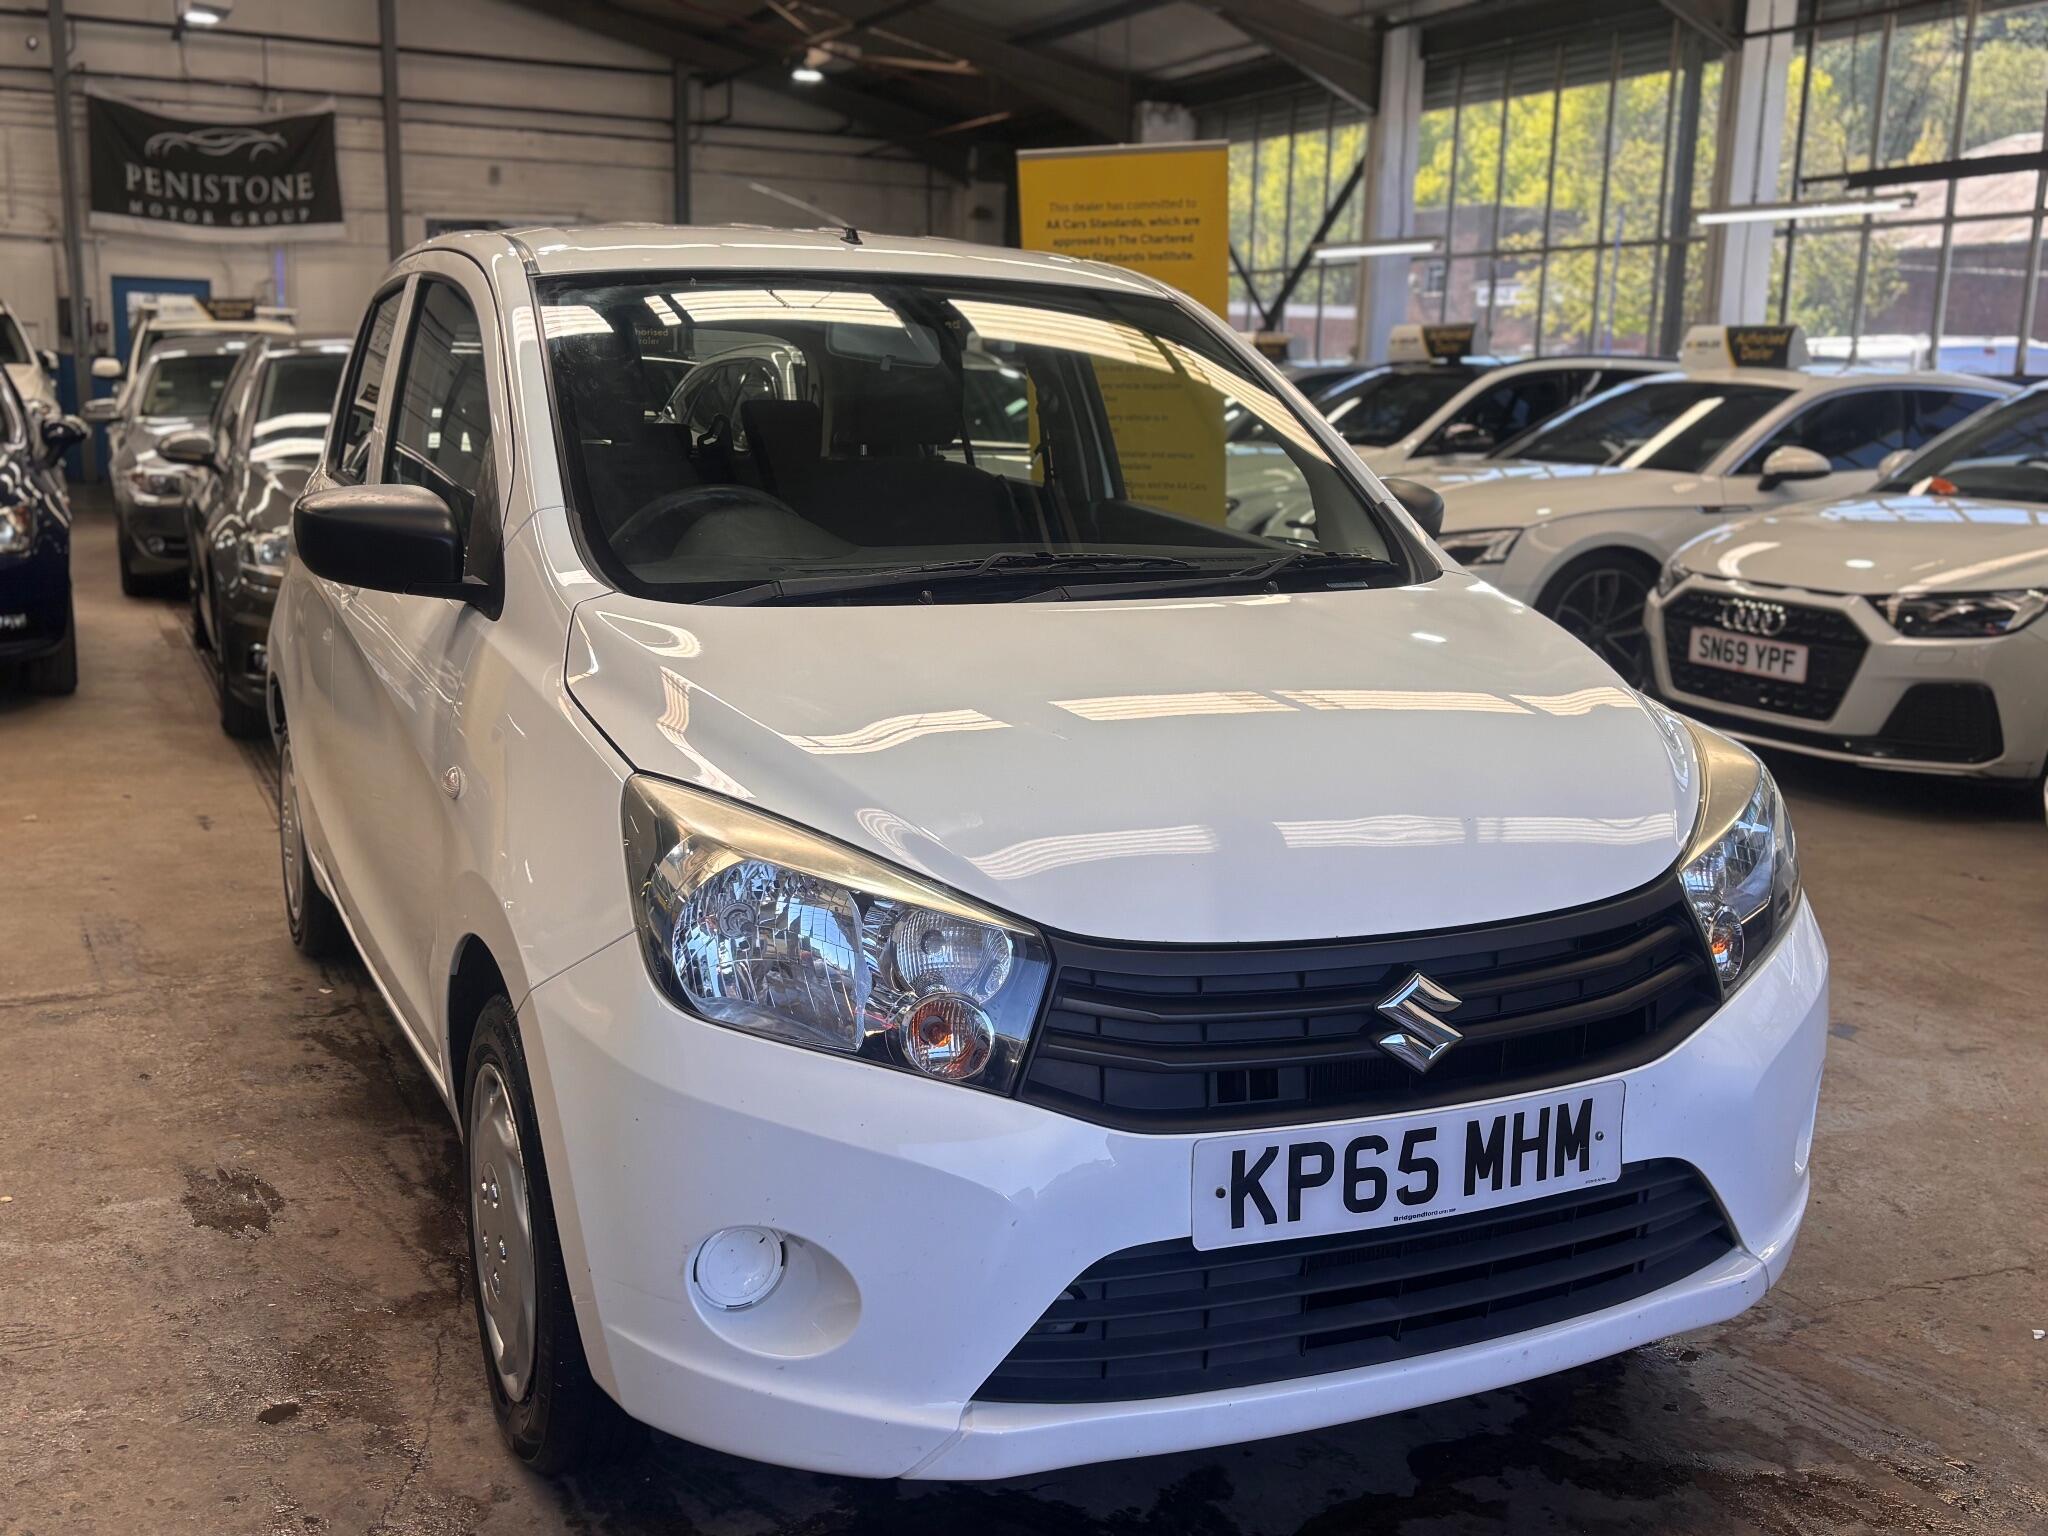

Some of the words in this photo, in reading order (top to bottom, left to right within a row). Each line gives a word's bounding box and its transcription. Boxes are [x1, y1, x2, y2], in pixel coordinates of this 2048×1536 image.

[125, 162, 314, 204] PENISTONE
[129, 200, 215, 225] MOTOR
[231, 208, 310, 226] GROUP
[1073, 201, 1103, 212] dealer
[1106, 200, 1124, 211] has
[1127, 198, 1183, 210] committed
[1046, 219, 1060, 230] AA
[1063, 218, 1086, 230] Cars
[1149, 215, 1180, 227] which
[1184, 216, 1200, 227] are
[1053, 236, 1100, 248] approved
[1104, 235, 1115, 247] by
[1118, 234, 1137, 245] The
[1140, 233, 1194, 245] Chartered
[1699, 634, 1749, 666] SN69
[1754, 643, 1797, 674] YPF
[1230, 1126, 1440, 1230] KP65
[1463, 1097, 1594, 1197] MHM
